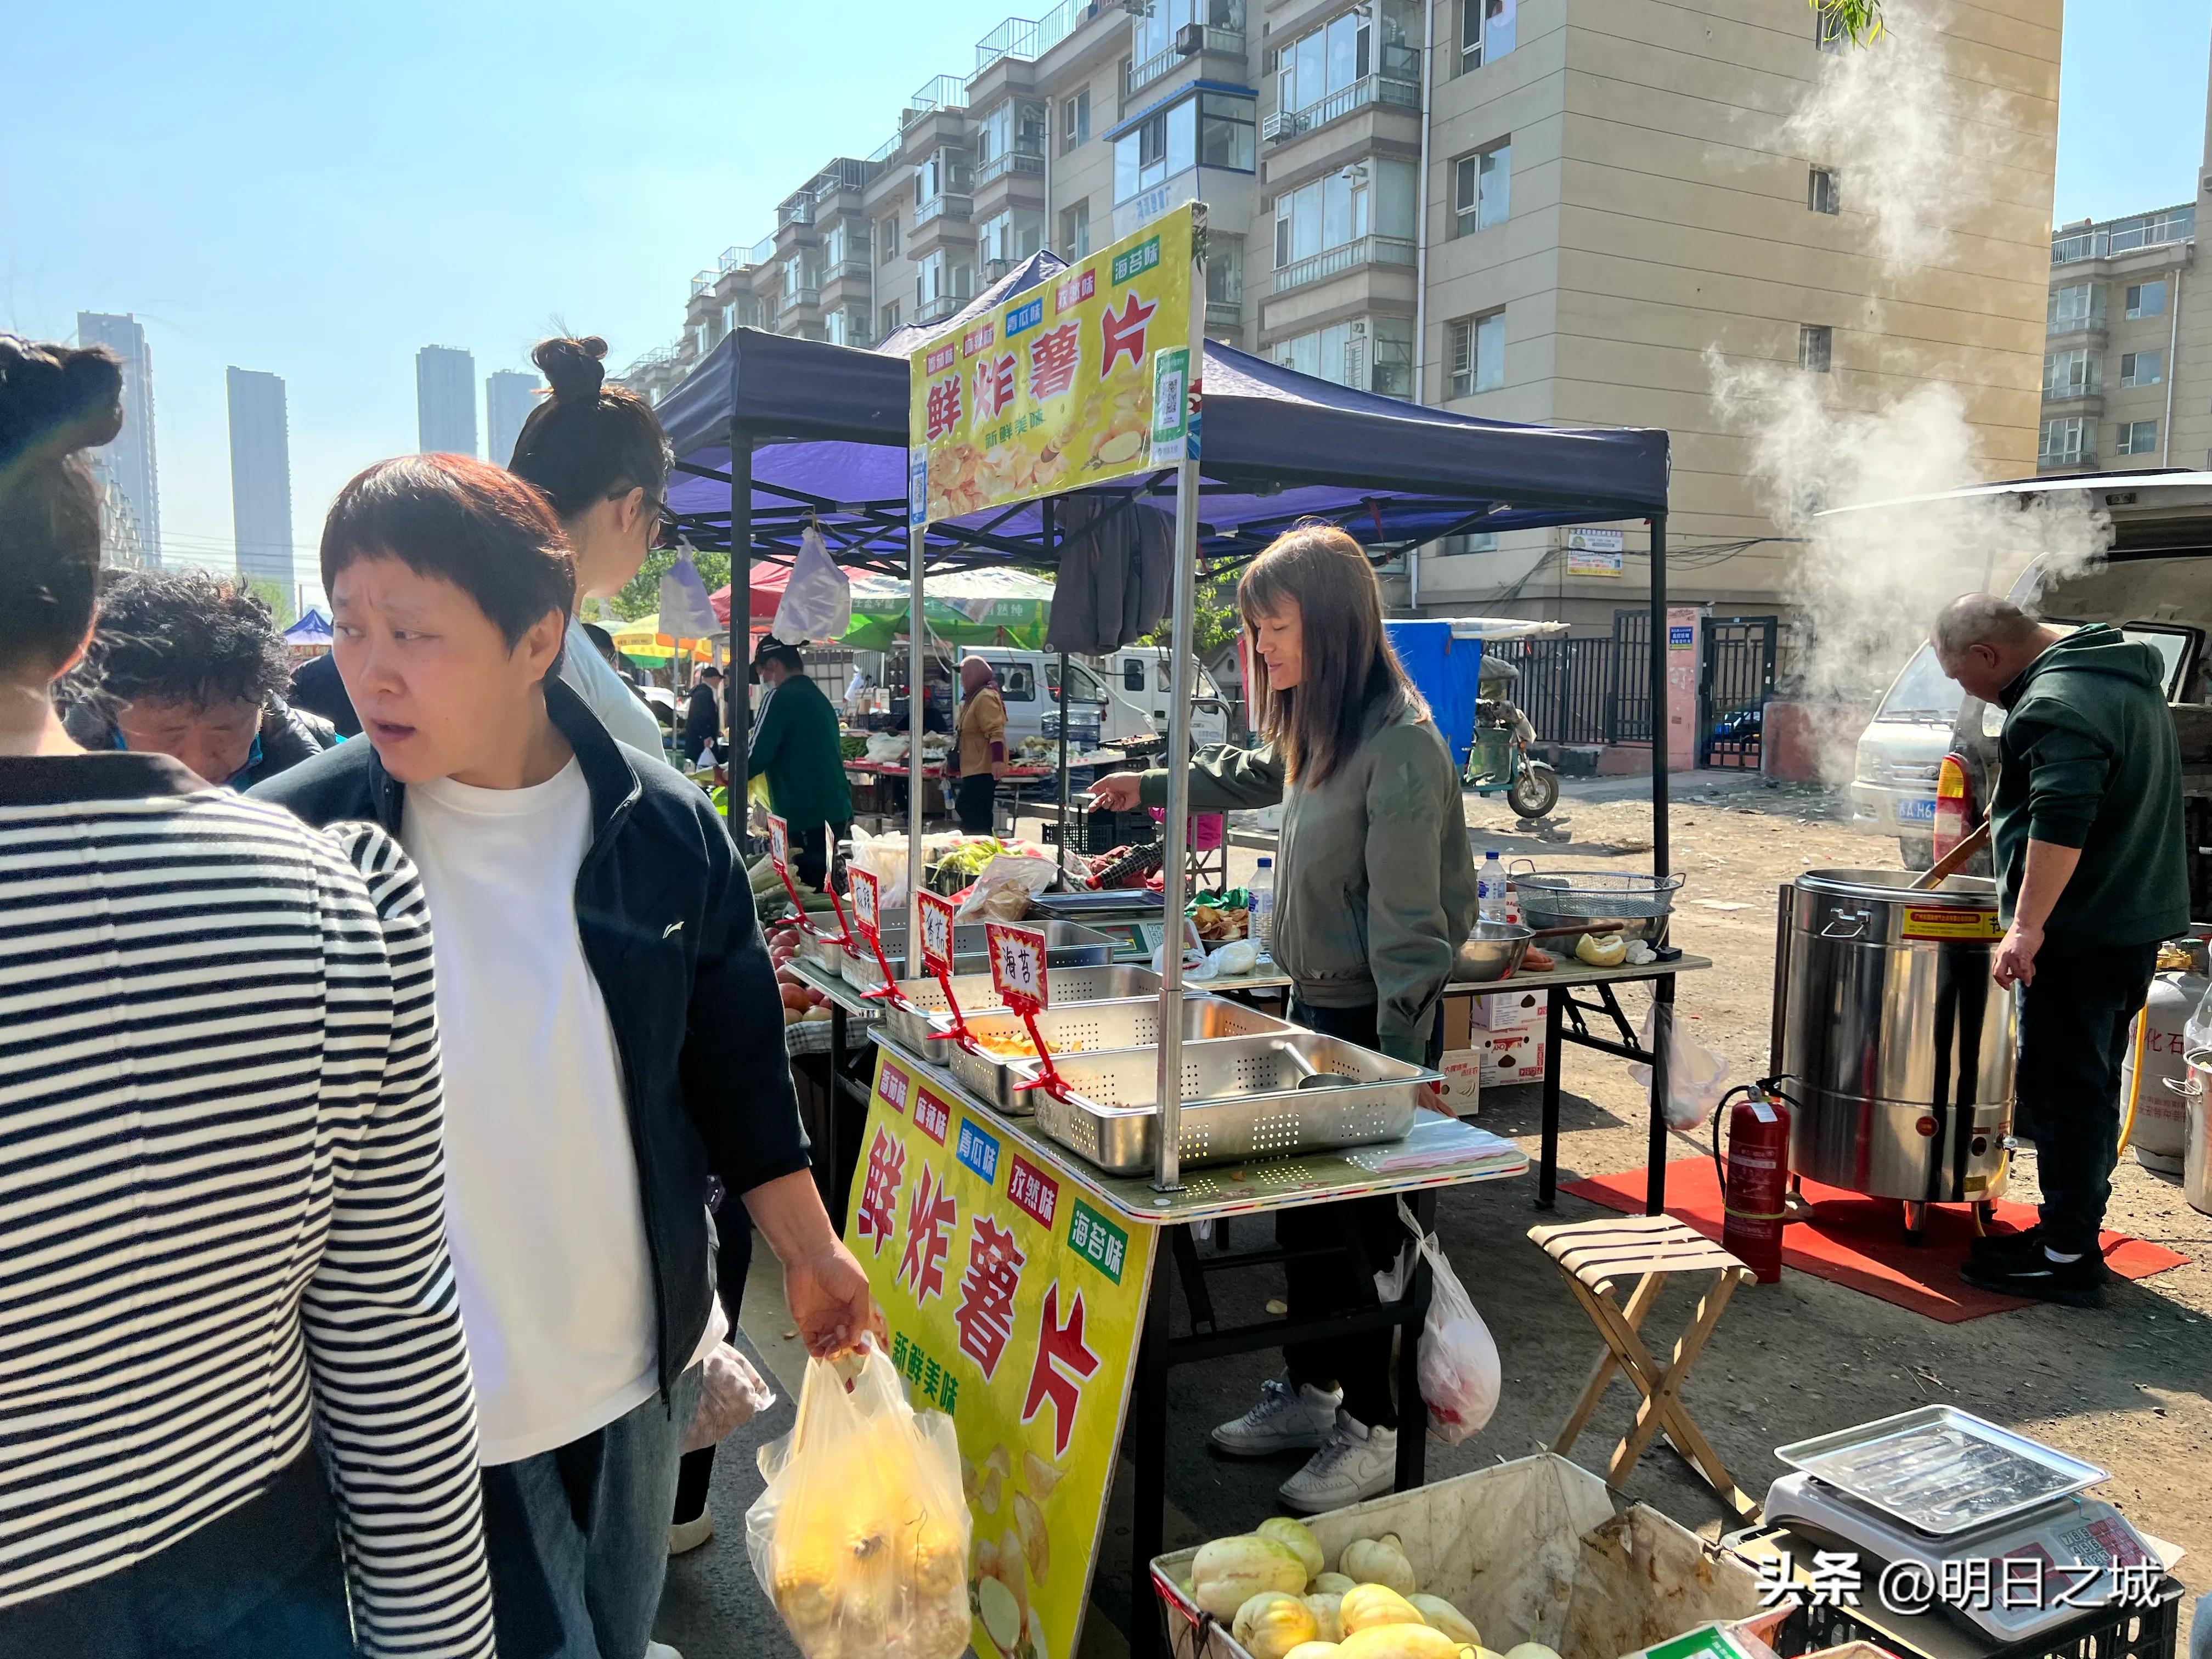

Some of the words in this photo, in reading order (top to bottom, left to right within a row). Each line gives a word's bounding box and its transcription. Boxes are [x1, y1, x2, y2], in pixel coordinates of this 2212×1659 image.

[1115, 242, 1158, 280] 海苔味
[1058, 279, 1094, 310] 孜然味
[1007, 303, 1041, 333] 青瓜味
[926, 290, 1158, 440] 鲜炸薯片
[927, 348, 953, 374] 番茄味
[985, 409, 1045, 449] 新鲜美味
[926, 909, 945, 954] 番茄
[1002, 945, 1031, 984] 海苔
[880, 1069, 907, 1109] 番茄味
[916, 1097, 947, 1140] 麻辣味
[960, 1128, 996, 1177] 青瓜味
[1011, 1158, 1057, 1220] 孜然味
[1073, 1208, 1125, 1277] 海苔味
[858, 1123, 1101, 1462] 鲜炸薯片
[892, 1331, 960, 1416] 新鲜美味
[2072, 1532, 2080, 1541] 8
[2073, 1547, 2081, 1555] 4
[2091, 1540, 2100, 1549] 6
[2091, 1555, 2101, 1564] 2
[2101, 1551, 2110, 1560] 3
